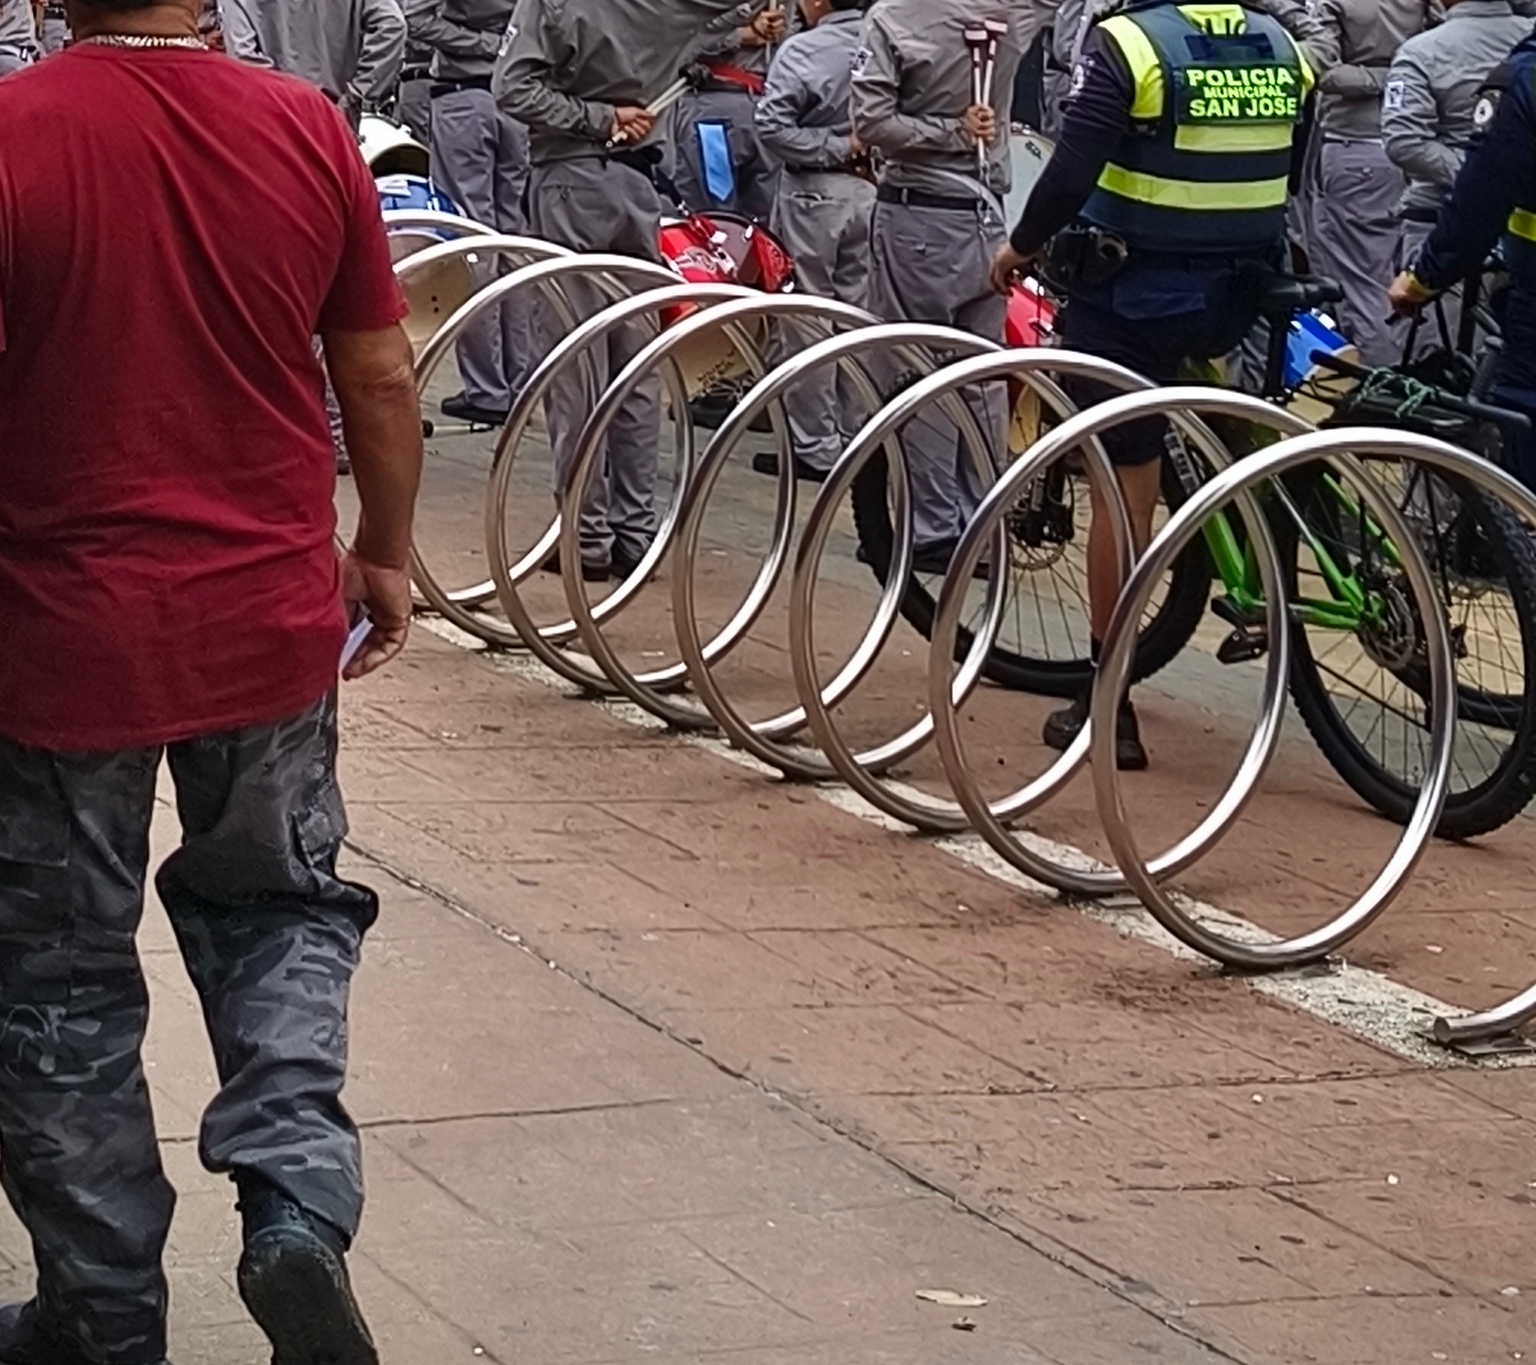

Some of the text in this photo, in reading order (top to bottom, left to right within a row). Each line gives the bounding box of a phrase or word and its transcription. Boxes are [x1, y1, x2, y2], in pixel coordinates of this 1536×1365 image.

[1186, 68, 1295, 86] POLICIA
[1203, 85, 1286, 98] MUNICIPAL
[1189, 98, 1297, 117] SAN JOSE
